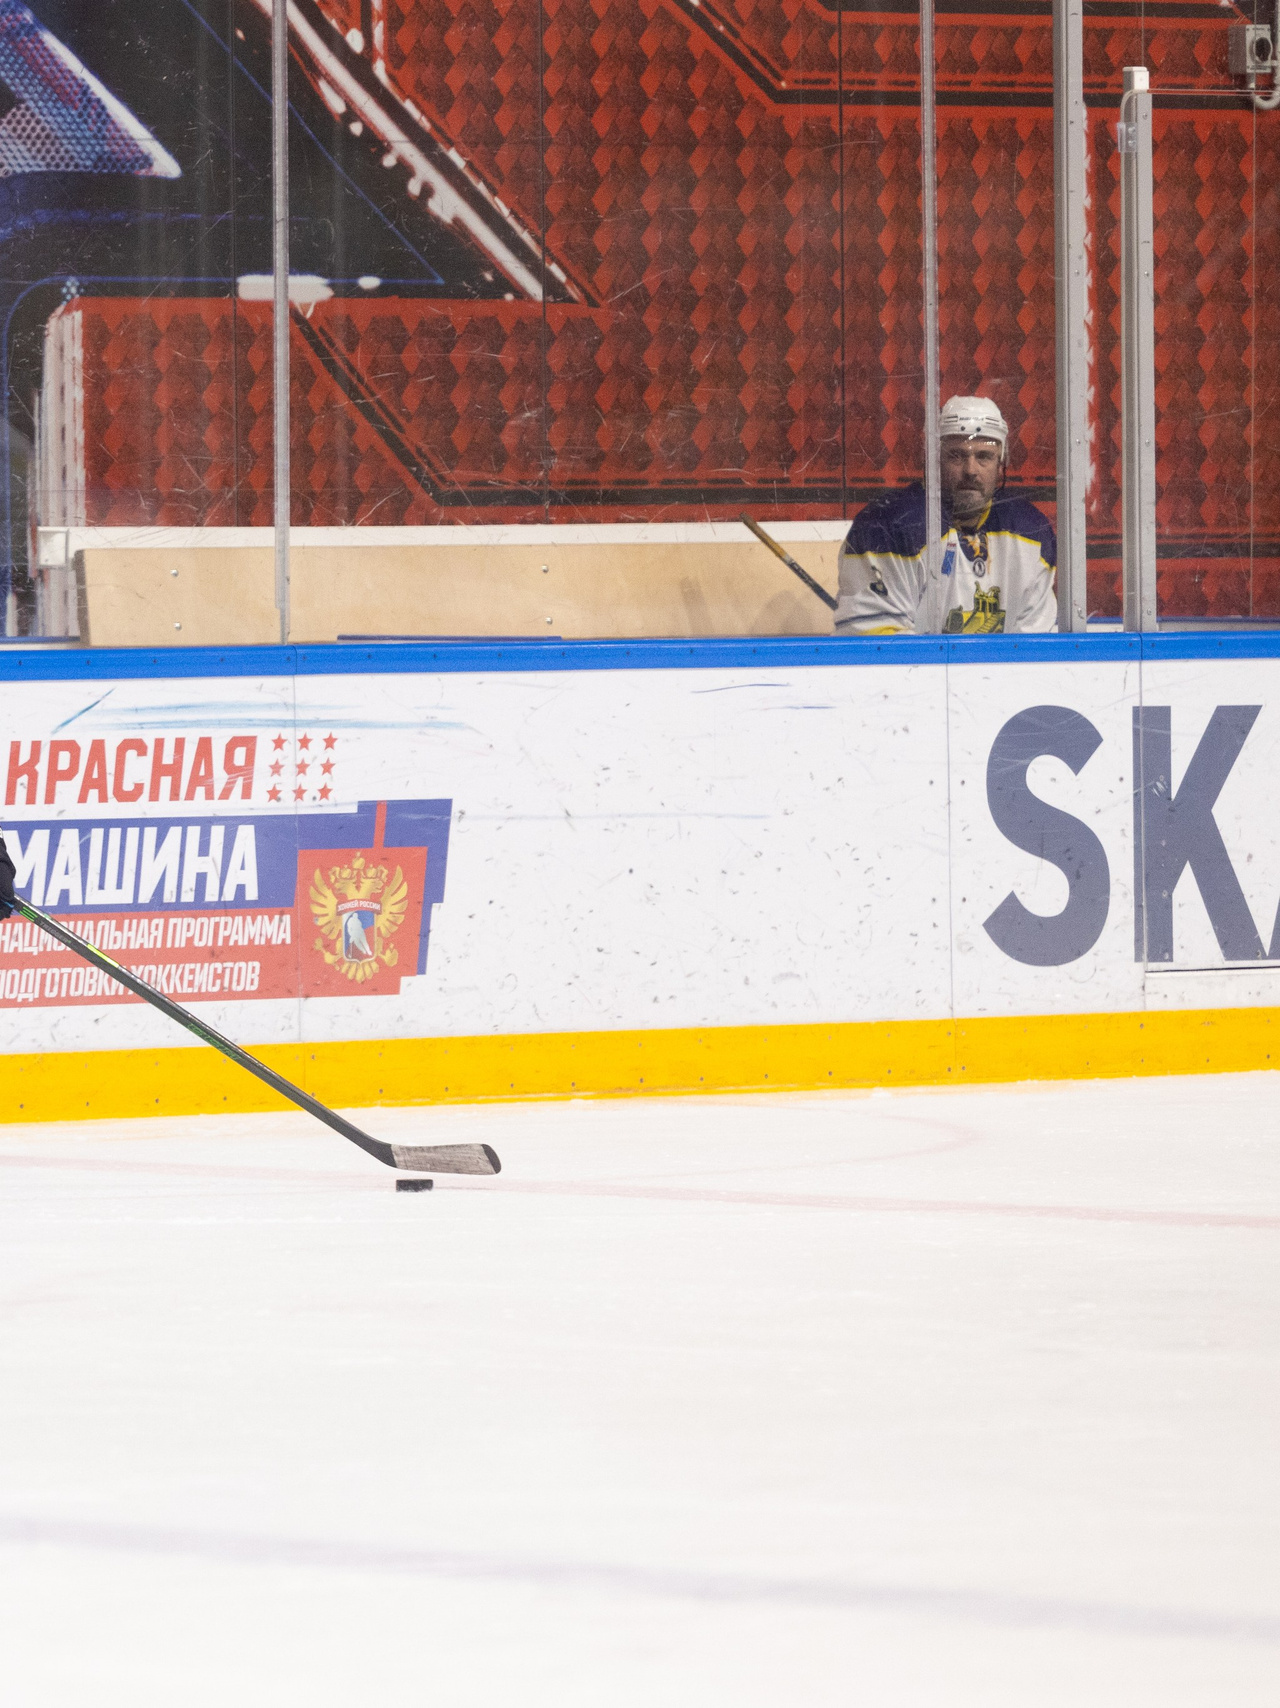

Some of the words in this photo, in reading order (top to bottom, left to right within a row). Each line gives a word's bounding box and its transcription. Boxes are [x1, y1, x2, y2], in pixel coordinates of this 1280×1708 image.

[4, 735, 258, 806] КРАСНАЯ
[1, 824, 259, 907] МАШИНА
[982, 704, 1280, 967] SK
[166, 914, 292, 949] ПРОГРАММА
